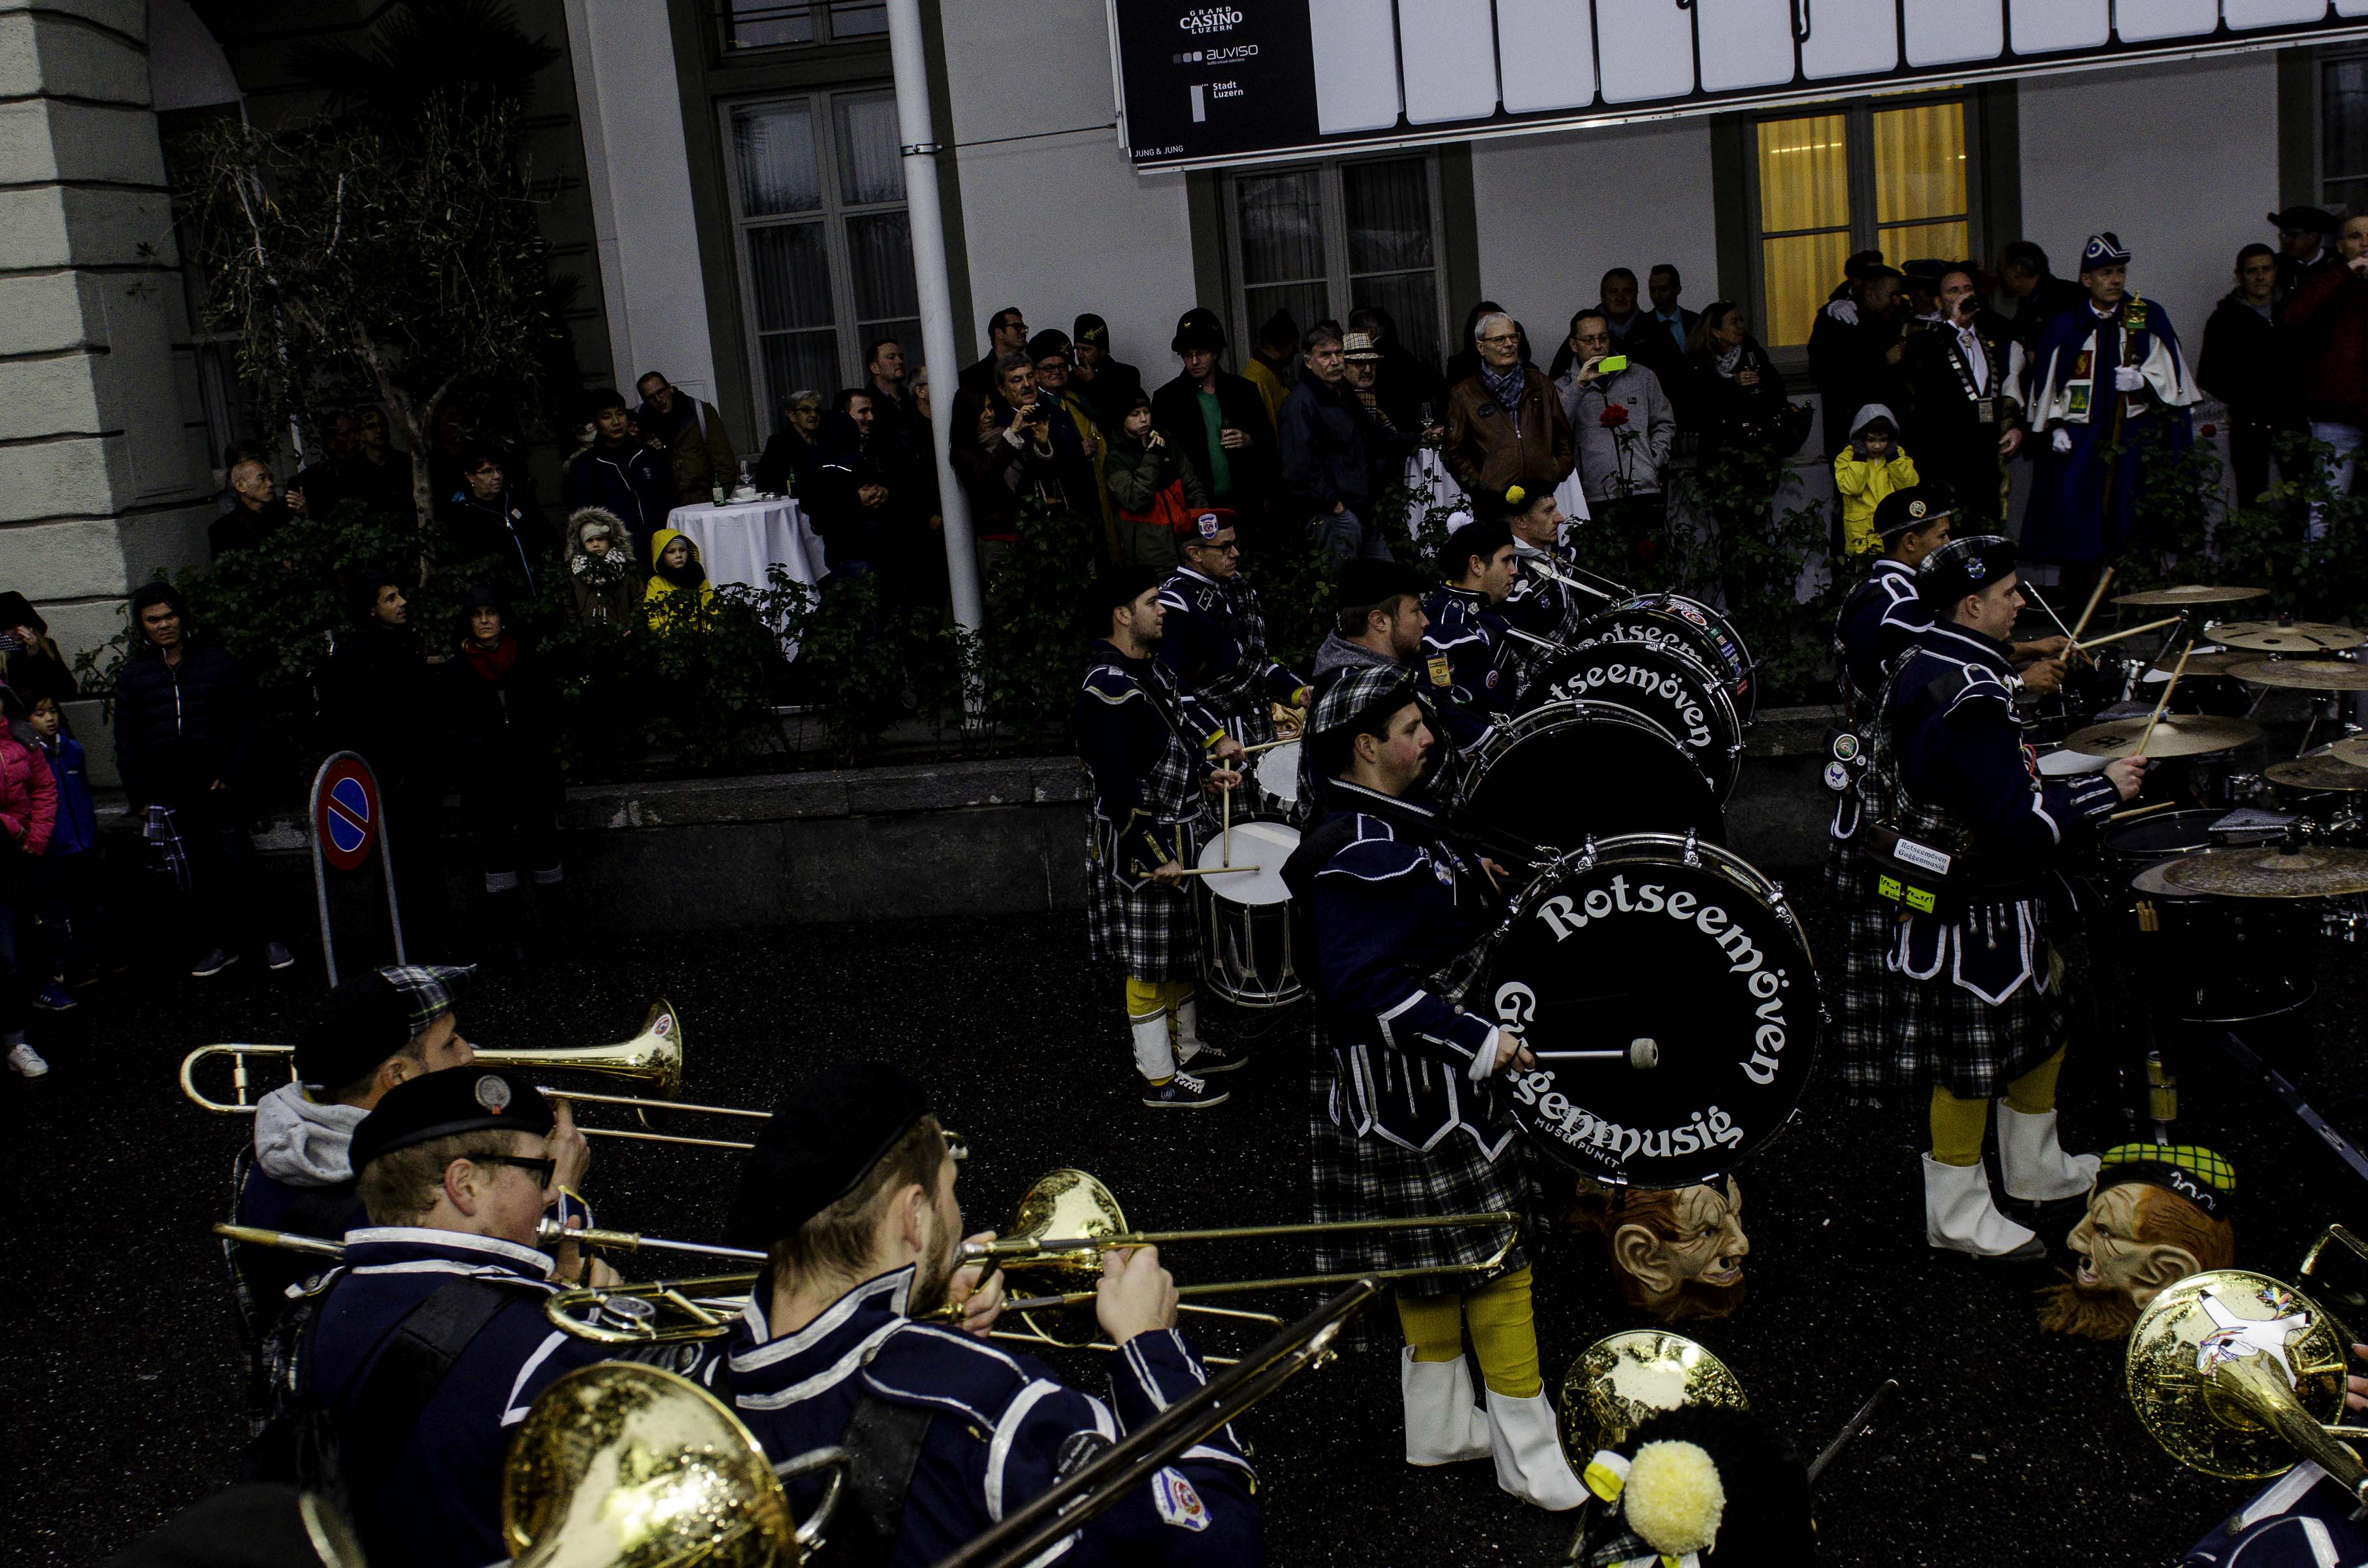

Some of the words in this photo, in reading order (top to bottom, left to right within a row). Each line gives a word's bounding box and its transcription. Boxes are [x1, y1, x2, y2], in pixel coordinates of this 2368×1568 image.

[1189, 6, 1232, 16] GRAND
[1179, 11, 1243, 29] CASINO
[1191, 24, 1233, 35] LUZERN
[1213, 80, 1238, 91] Stadt
[1213, 89, 1244, 99] Luzern
[1134, 148, 1155, 157] JUNG
[1164, 145, 1184, 155] JUNG
[1544, 664, 1711, 747] tseemöven
[1536, 874, 1789, 1085] Rotseemöven
